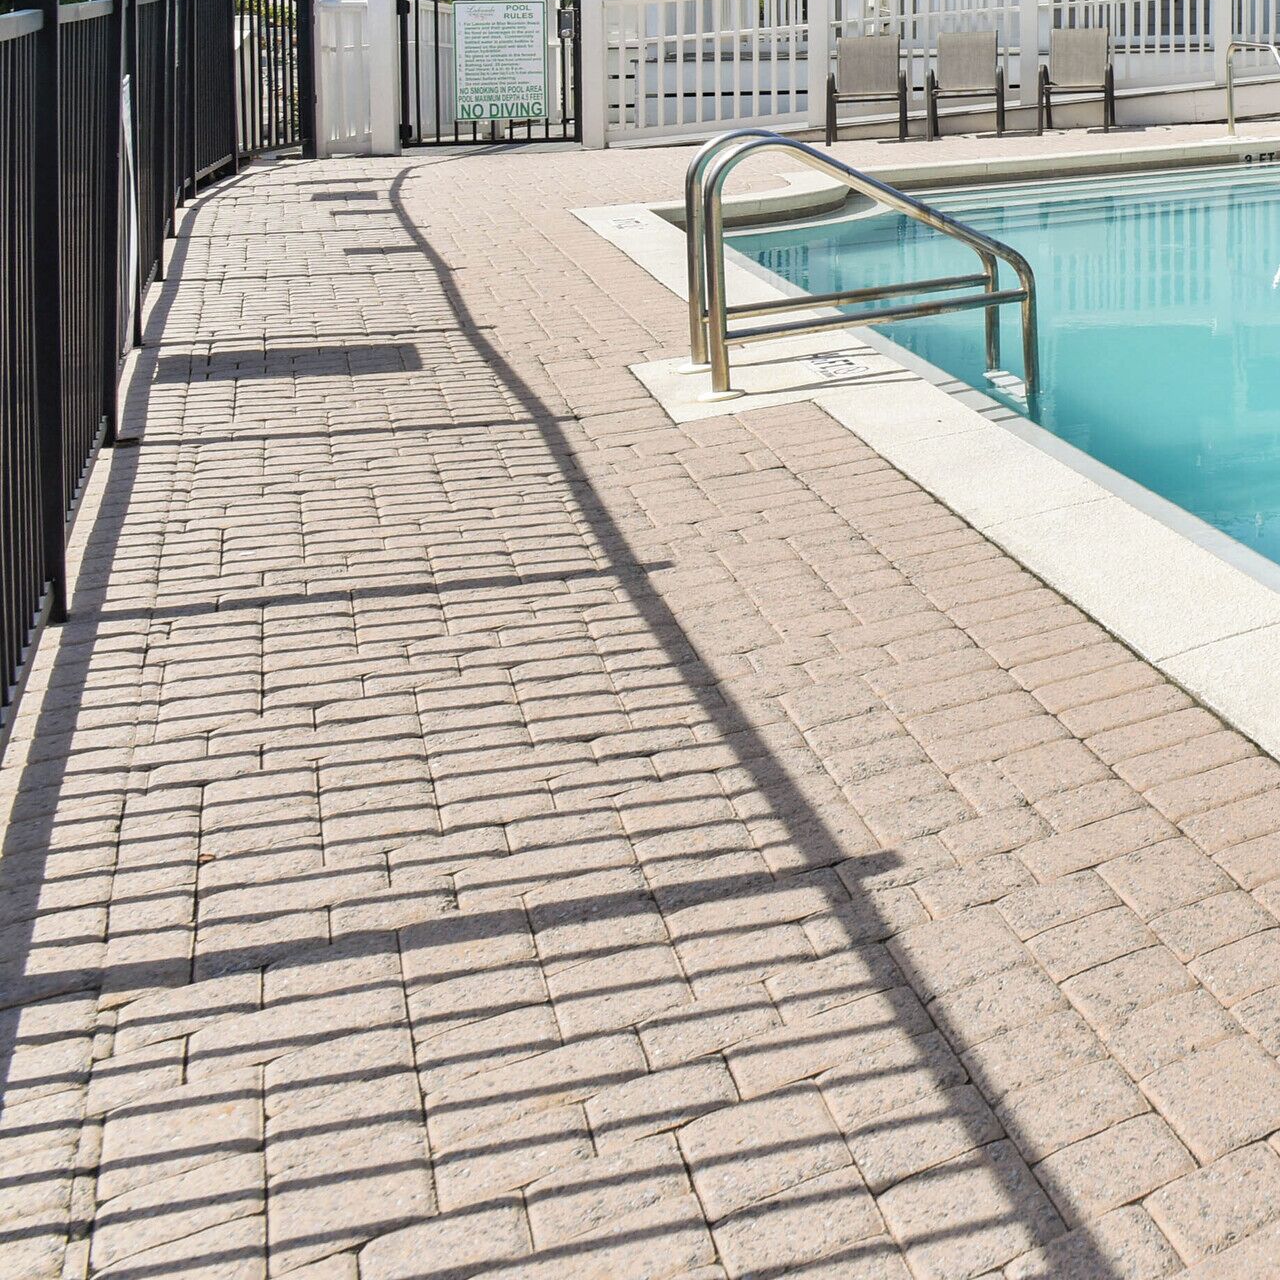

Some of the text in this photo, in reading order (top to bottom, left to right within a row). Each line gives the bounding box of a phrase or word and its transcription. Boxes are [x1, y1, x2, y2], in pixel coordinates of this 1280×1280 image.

[460, 87, 469, 95] NO
[470, 86, 499, 95] SMOKING
[500, 86, 506, 94] IN
[525, 85, 542, 93] AREA
[459, 95, 474, 103] POOL
[474, 94, 501, 102] MAXIMUM
[461, 101, 543, 118] NO DIVING
